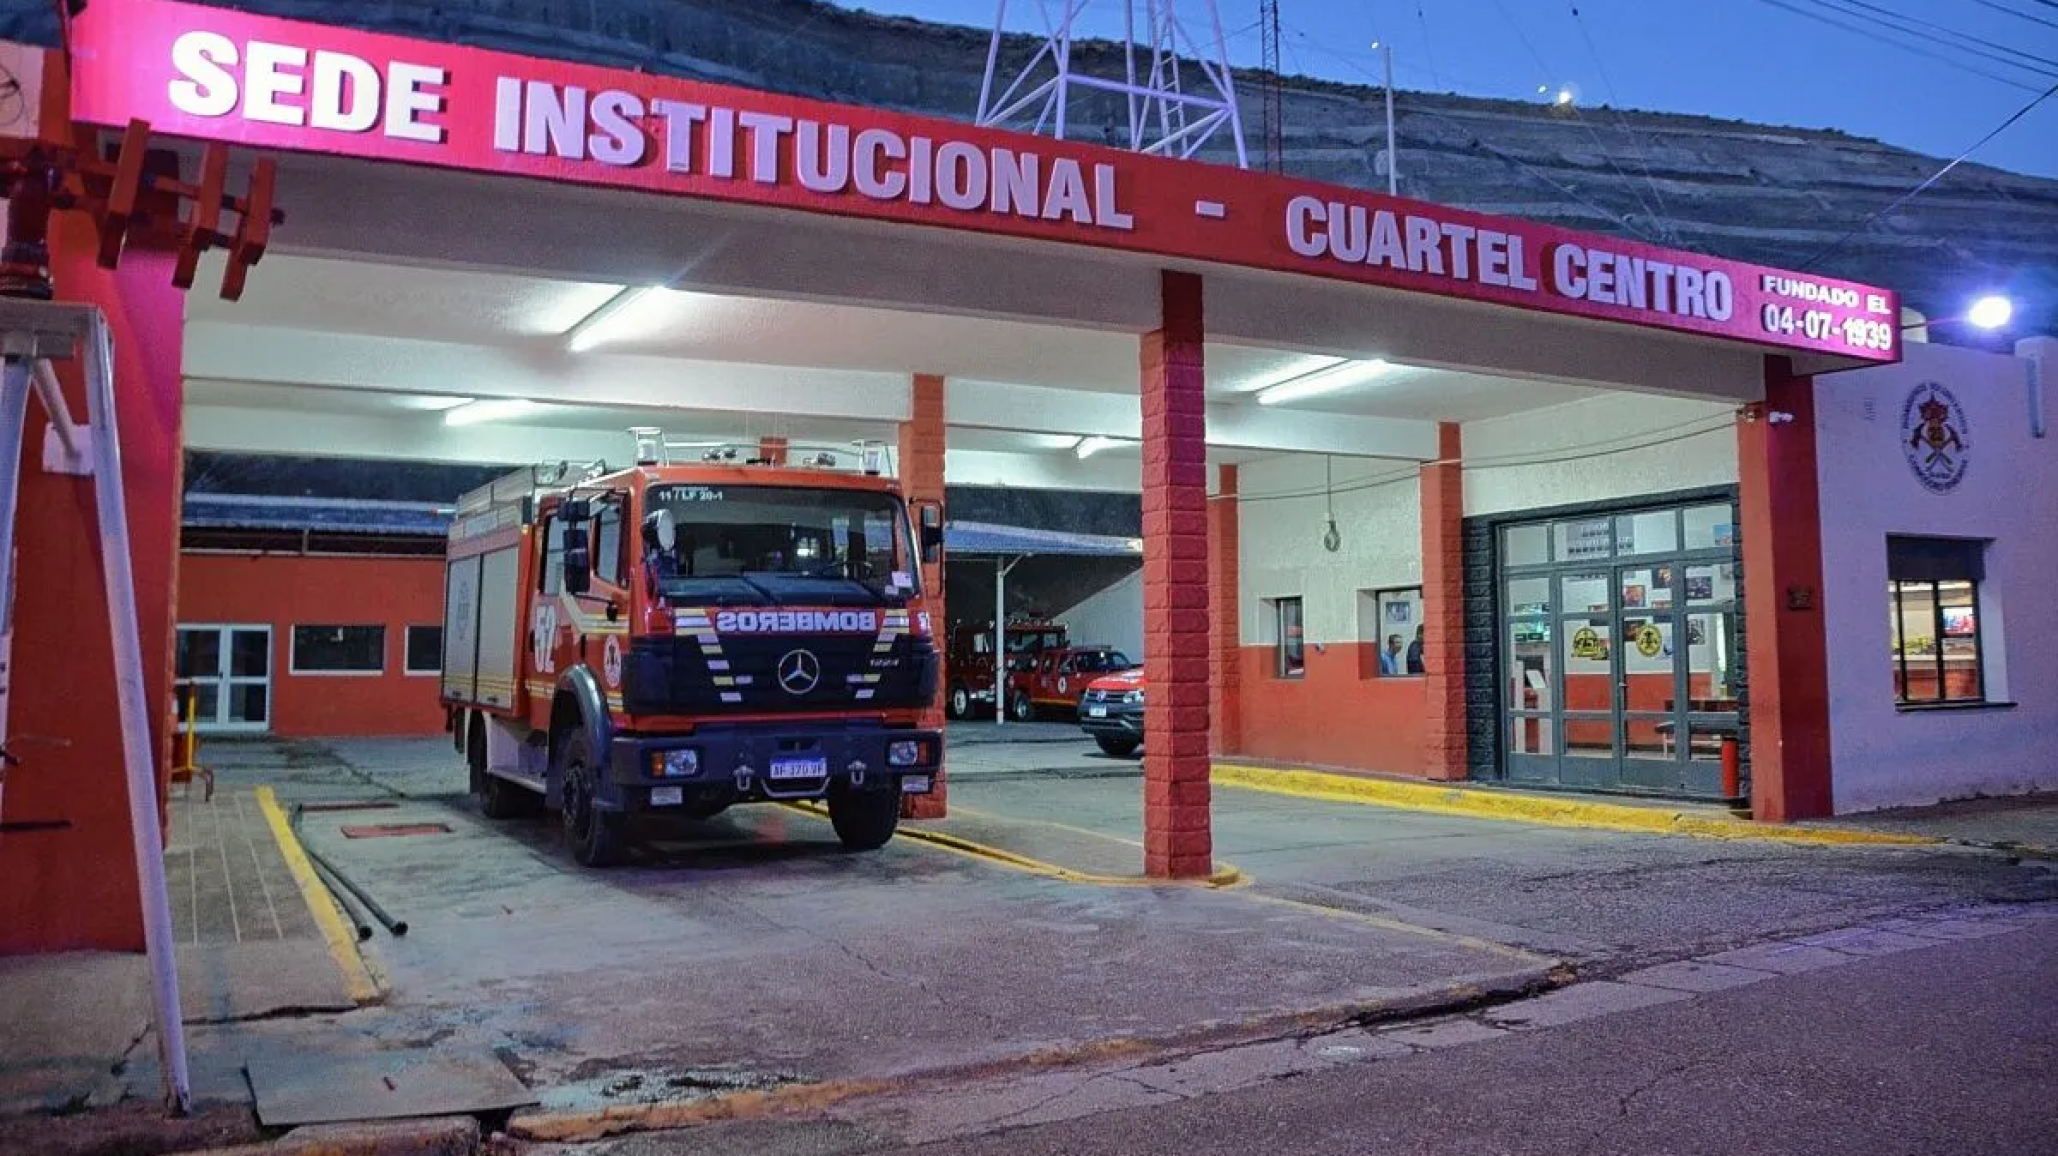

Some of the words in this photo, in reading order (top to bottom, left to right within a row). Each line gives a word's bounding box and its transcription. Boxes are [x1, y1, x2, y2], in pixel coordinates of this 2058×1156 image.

[169, 30, 445, 143] SEDE
[493, 76, 1134, 230] INSTITUCIONAL
[1286, 196, 1538, 290] CUARTEL
[1554, 243, 1733, 321] CENTRO
[1763, 275, 1859, 307] FUNDADO
[1866, 294, 1891, 314] EL
[1764, 303, 1893, 350] 04-07-1939
